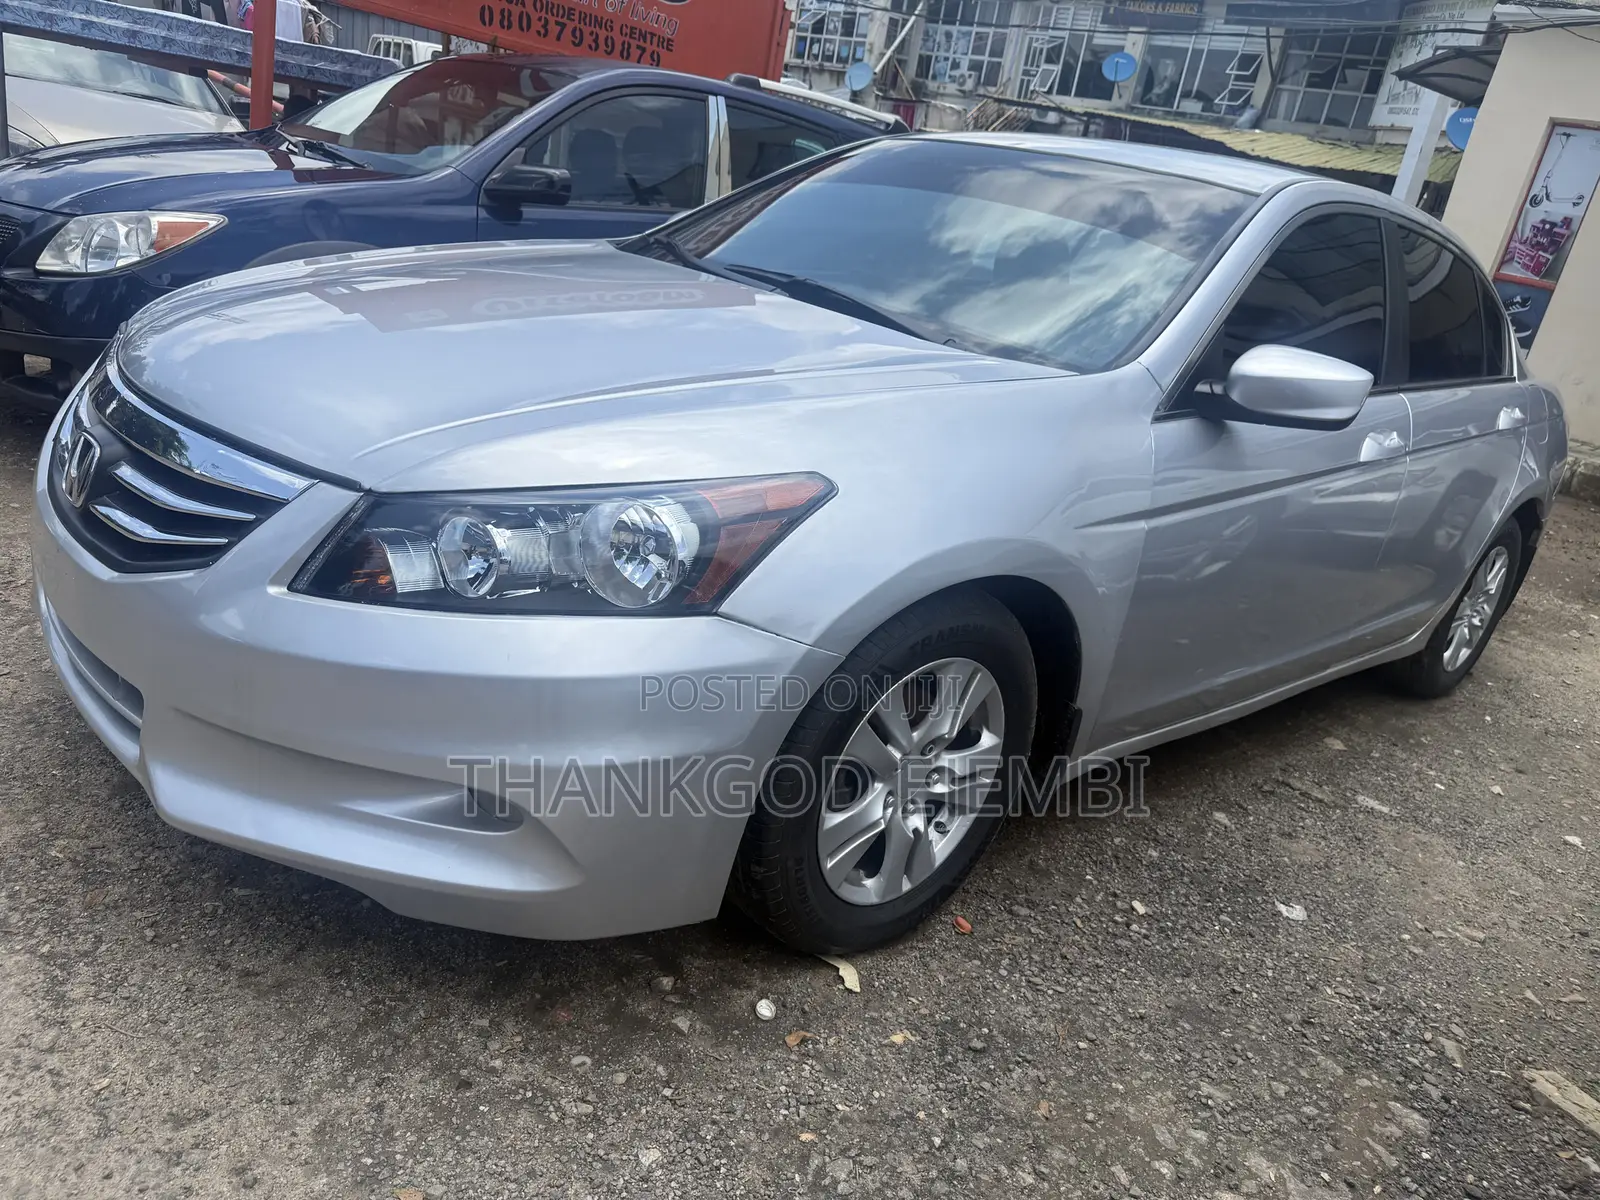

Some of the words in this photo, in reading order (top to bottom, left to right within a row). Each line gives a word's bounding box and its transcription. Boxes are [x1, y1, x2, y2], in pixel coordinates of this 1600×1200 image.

[479, 4, 661, 67] 08037939879
[532, 0, 614, 33] ORDERING
[619, 23, 675, 53] CENTRE
[604, 0, 625, 15] of
[629, 1, 680, 38] living
